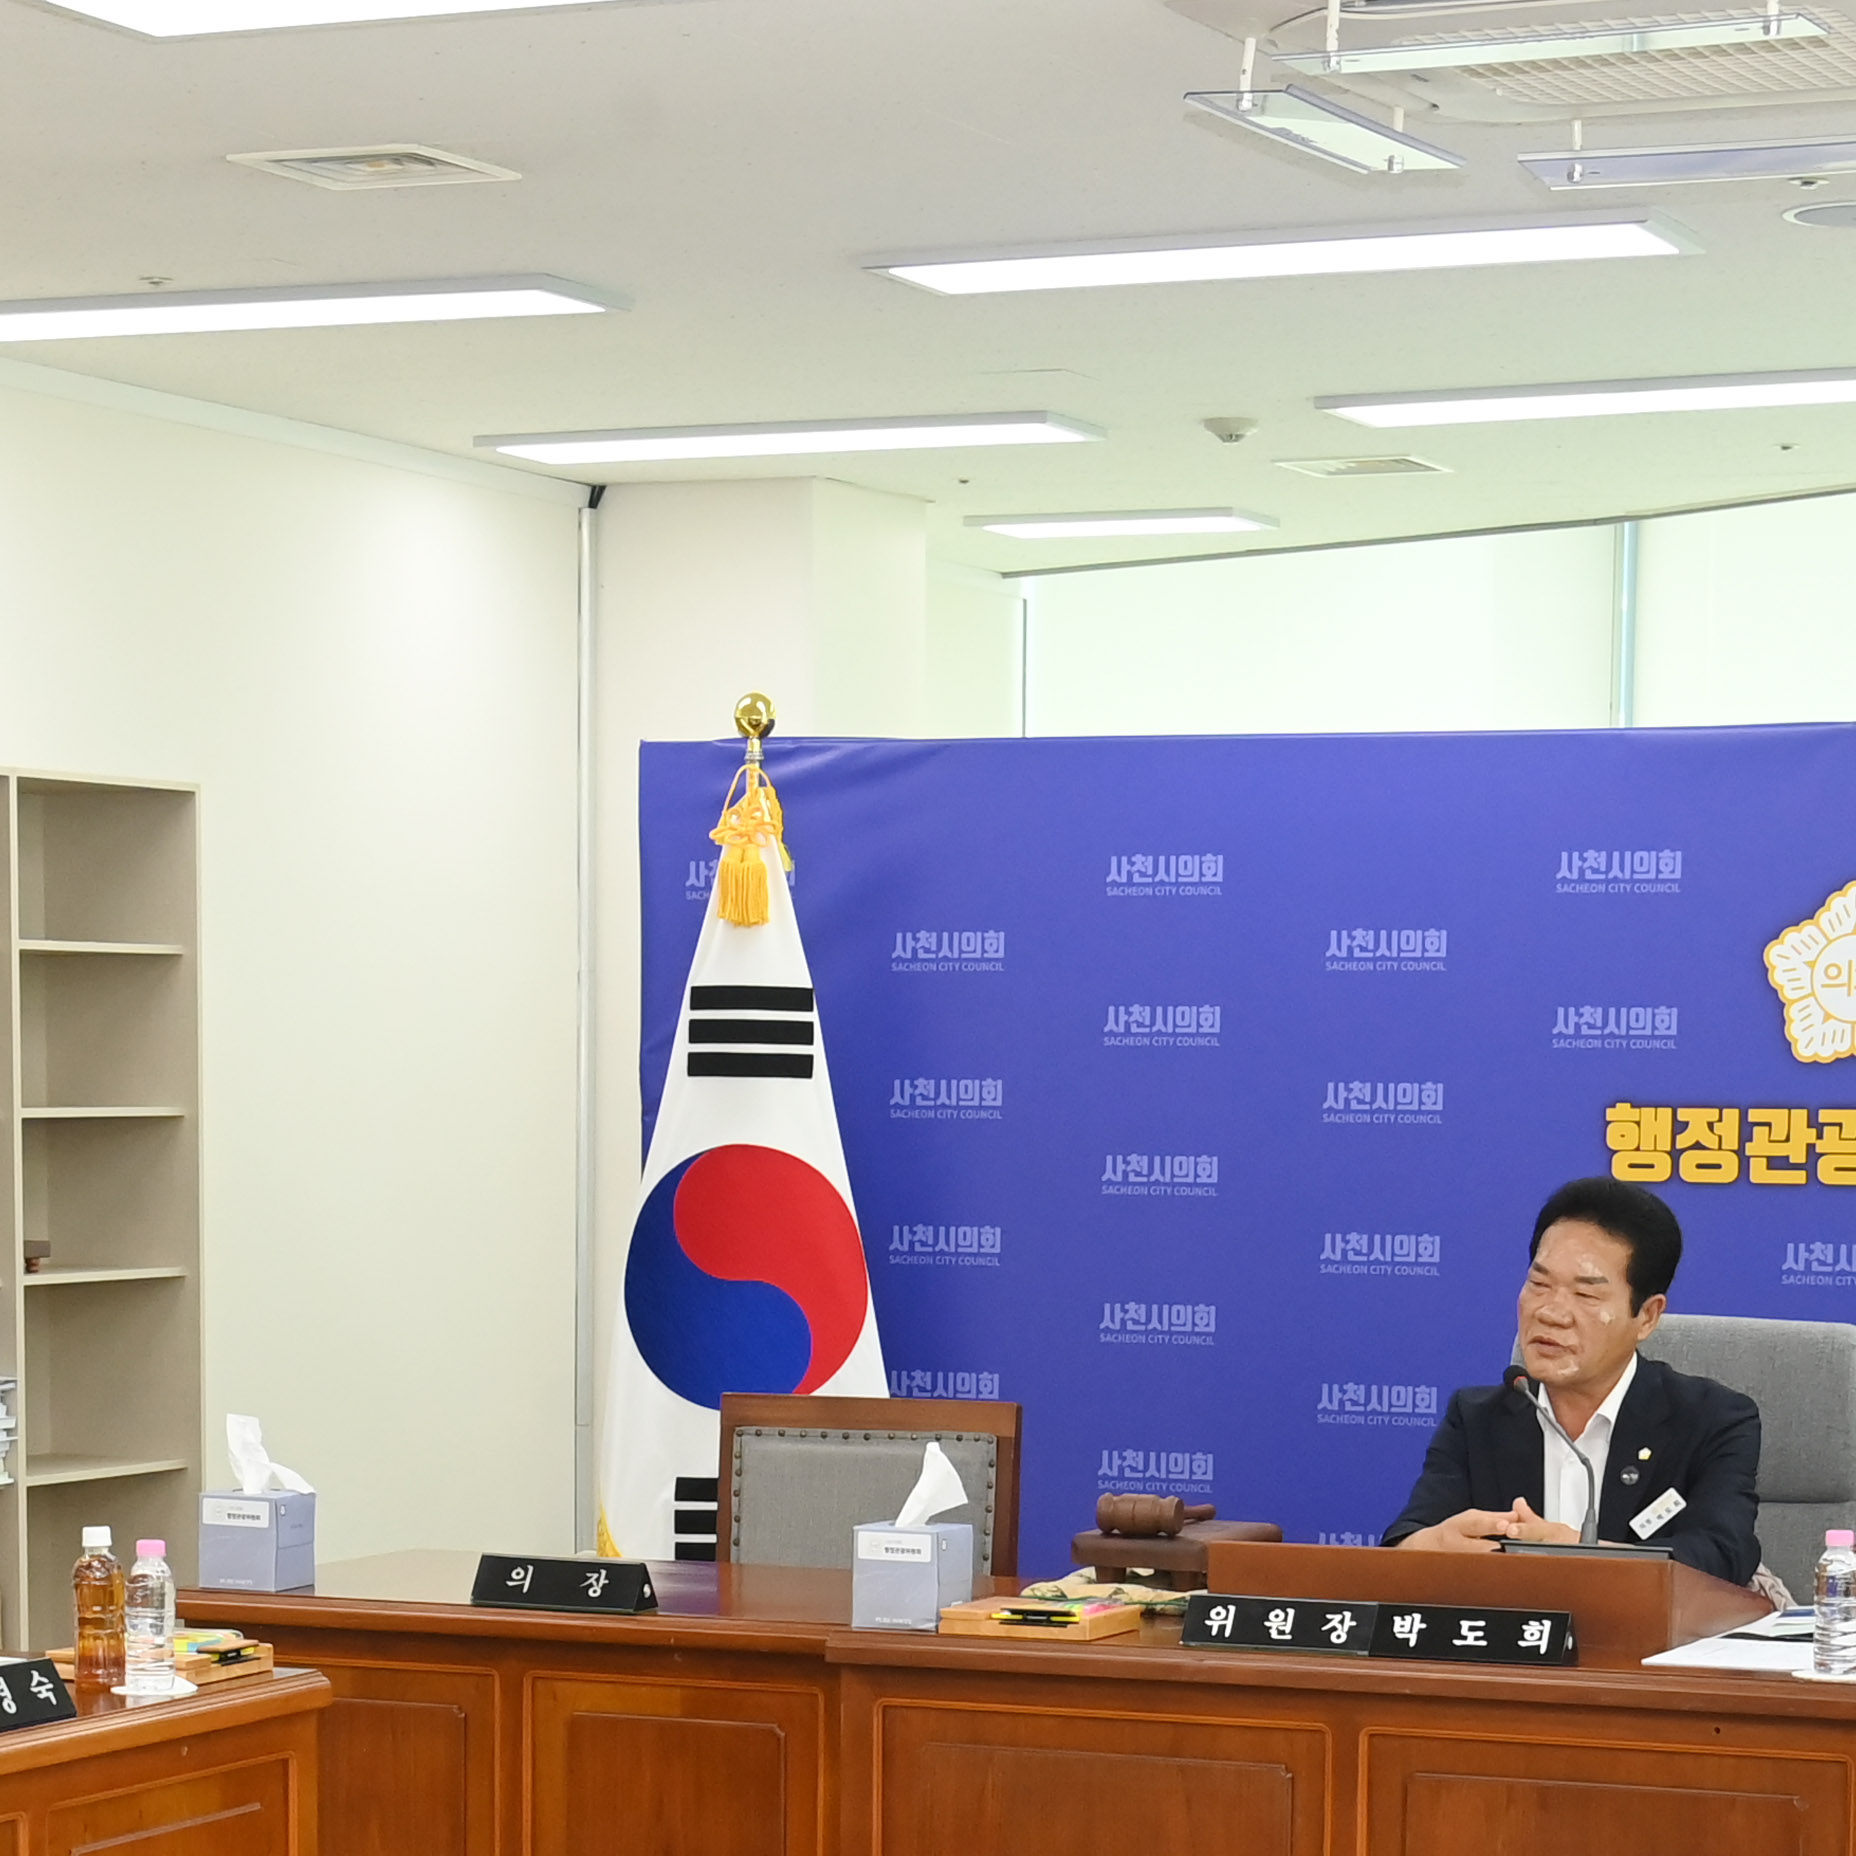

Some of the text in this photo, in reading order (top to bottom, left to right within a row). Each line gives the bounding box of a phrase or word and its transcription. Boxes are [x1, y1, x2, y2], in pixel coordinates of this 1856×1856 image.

[1106, 853, 1223, 883] 사천시의회
[1556, 849, 1682, 879] 사천시의회
[1106, 886, 1222, 896] SACHEON CITY COUNCIL
[1556, 883, 1680, 893] SACHEON CITY COUNCIL
[892, 930, 1005, 958] 사천시의회
[1325, 928, 1447, 957] 사천시의회
[892, 962, 1004, 971] SACHEON CITY COUNCIL
[1326, 961, 1447, 971] SACHEON CITY COUNCIL
[1104, 1004, 1221, 1033] 사천시의회
[1552, 1005, 1678, 1035] 사천시의회
[1104, 1037, 1220, 1046] SACHEON CITY COUNCIL
[1552, 1039, 1676, 1049] SACHEON CITY COUNCIL
[890, 1078, 1002, 1106] 사천시의회
[1322, 1081, 1444, 1110] 사천시의회
[890, 1109, 1002, 1119] SACHEON CITY COUNCIL
[1323, 1113, 1442, 1124] SACHEON CITY COUNCIL
[1101, 1154, 1218, 1183] 사천시의회
[1101, 1185, 1218, 1196] SACHEON CITY COUNCIL
[889, 1224, 1001, 1253] 사천시의회
[1320, 1232, 1440, 1263] 사천시의회
[889, 1255, 1000, 1266] SACHEON CITY COUNCIL
[1320, 1264, 1440, 1276] SACHEON CITY COUNCIL
[1782, 1275, 1832, 1285] SACHEON
[1099, 1302, 1216, 1332] 사천시의회
[1100, 1333, 1214, 1345] SACHEON CITY COUNCIL
[890, 1369, 1000, 1399] 사천시의회
[1317, 1382, 1437, 1413] 사천시의회
[1317, 1414, 1438, 1427] SACHEON CITY COUNCIL
[1098, 1449, 1213, 1480] 사천시의회
[1098, 1480, 1212, 1493] SACHEON CITY COUNCIL
[1204, 1604, 1552, 1655] 위원장 박도희
